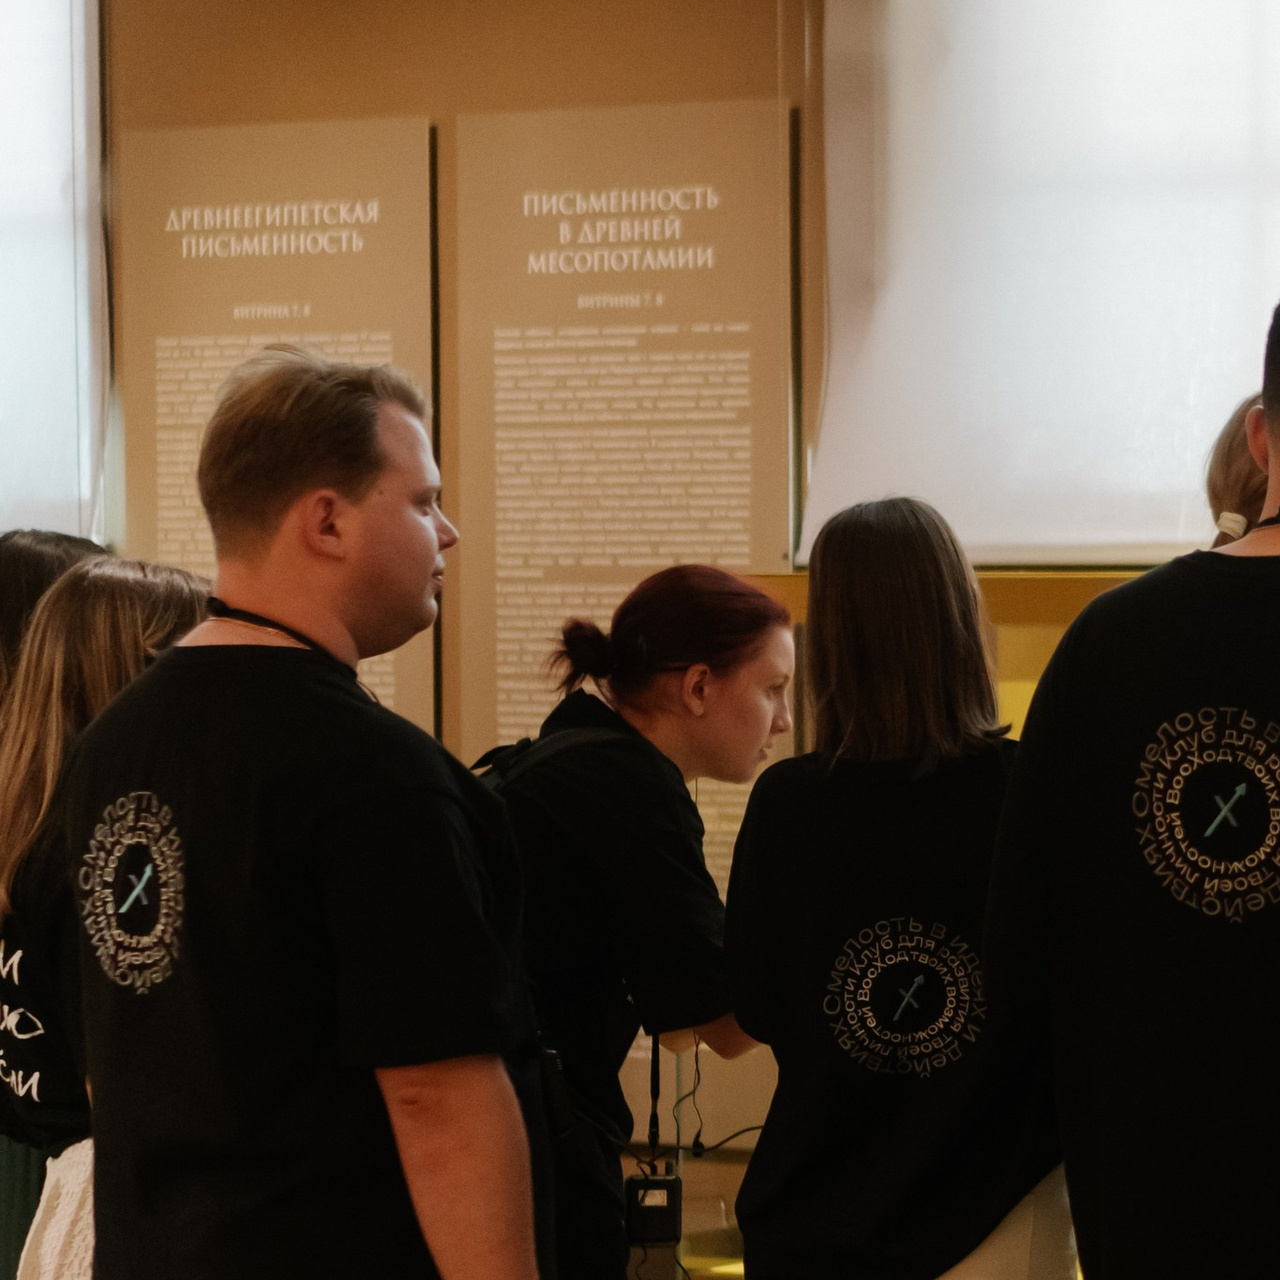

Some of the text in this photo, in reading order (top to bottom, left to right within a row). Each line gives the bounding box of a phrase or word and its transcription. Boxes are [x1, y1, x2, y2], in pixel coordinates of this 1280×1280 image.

[165, 199, 380, 232] ДРЕВНЕЕГИПЕТСКАЯ
[523, 187, 719, 217] ПИСЬМЕННОСТЬ
[559, 215, 682, 244] В ДРЕВНЕЙ
[181, 230, 363, 259] ПИСЬМЕННОСТЬ
[528, 247, 714, 275] МЕСОПОТАМИИ
[1221, 730, 1266, 755] для
[1235, 751, 1280, 804] твоих
[898, 935, 935, 950] для
[910, 951, 954, 984] твоих
